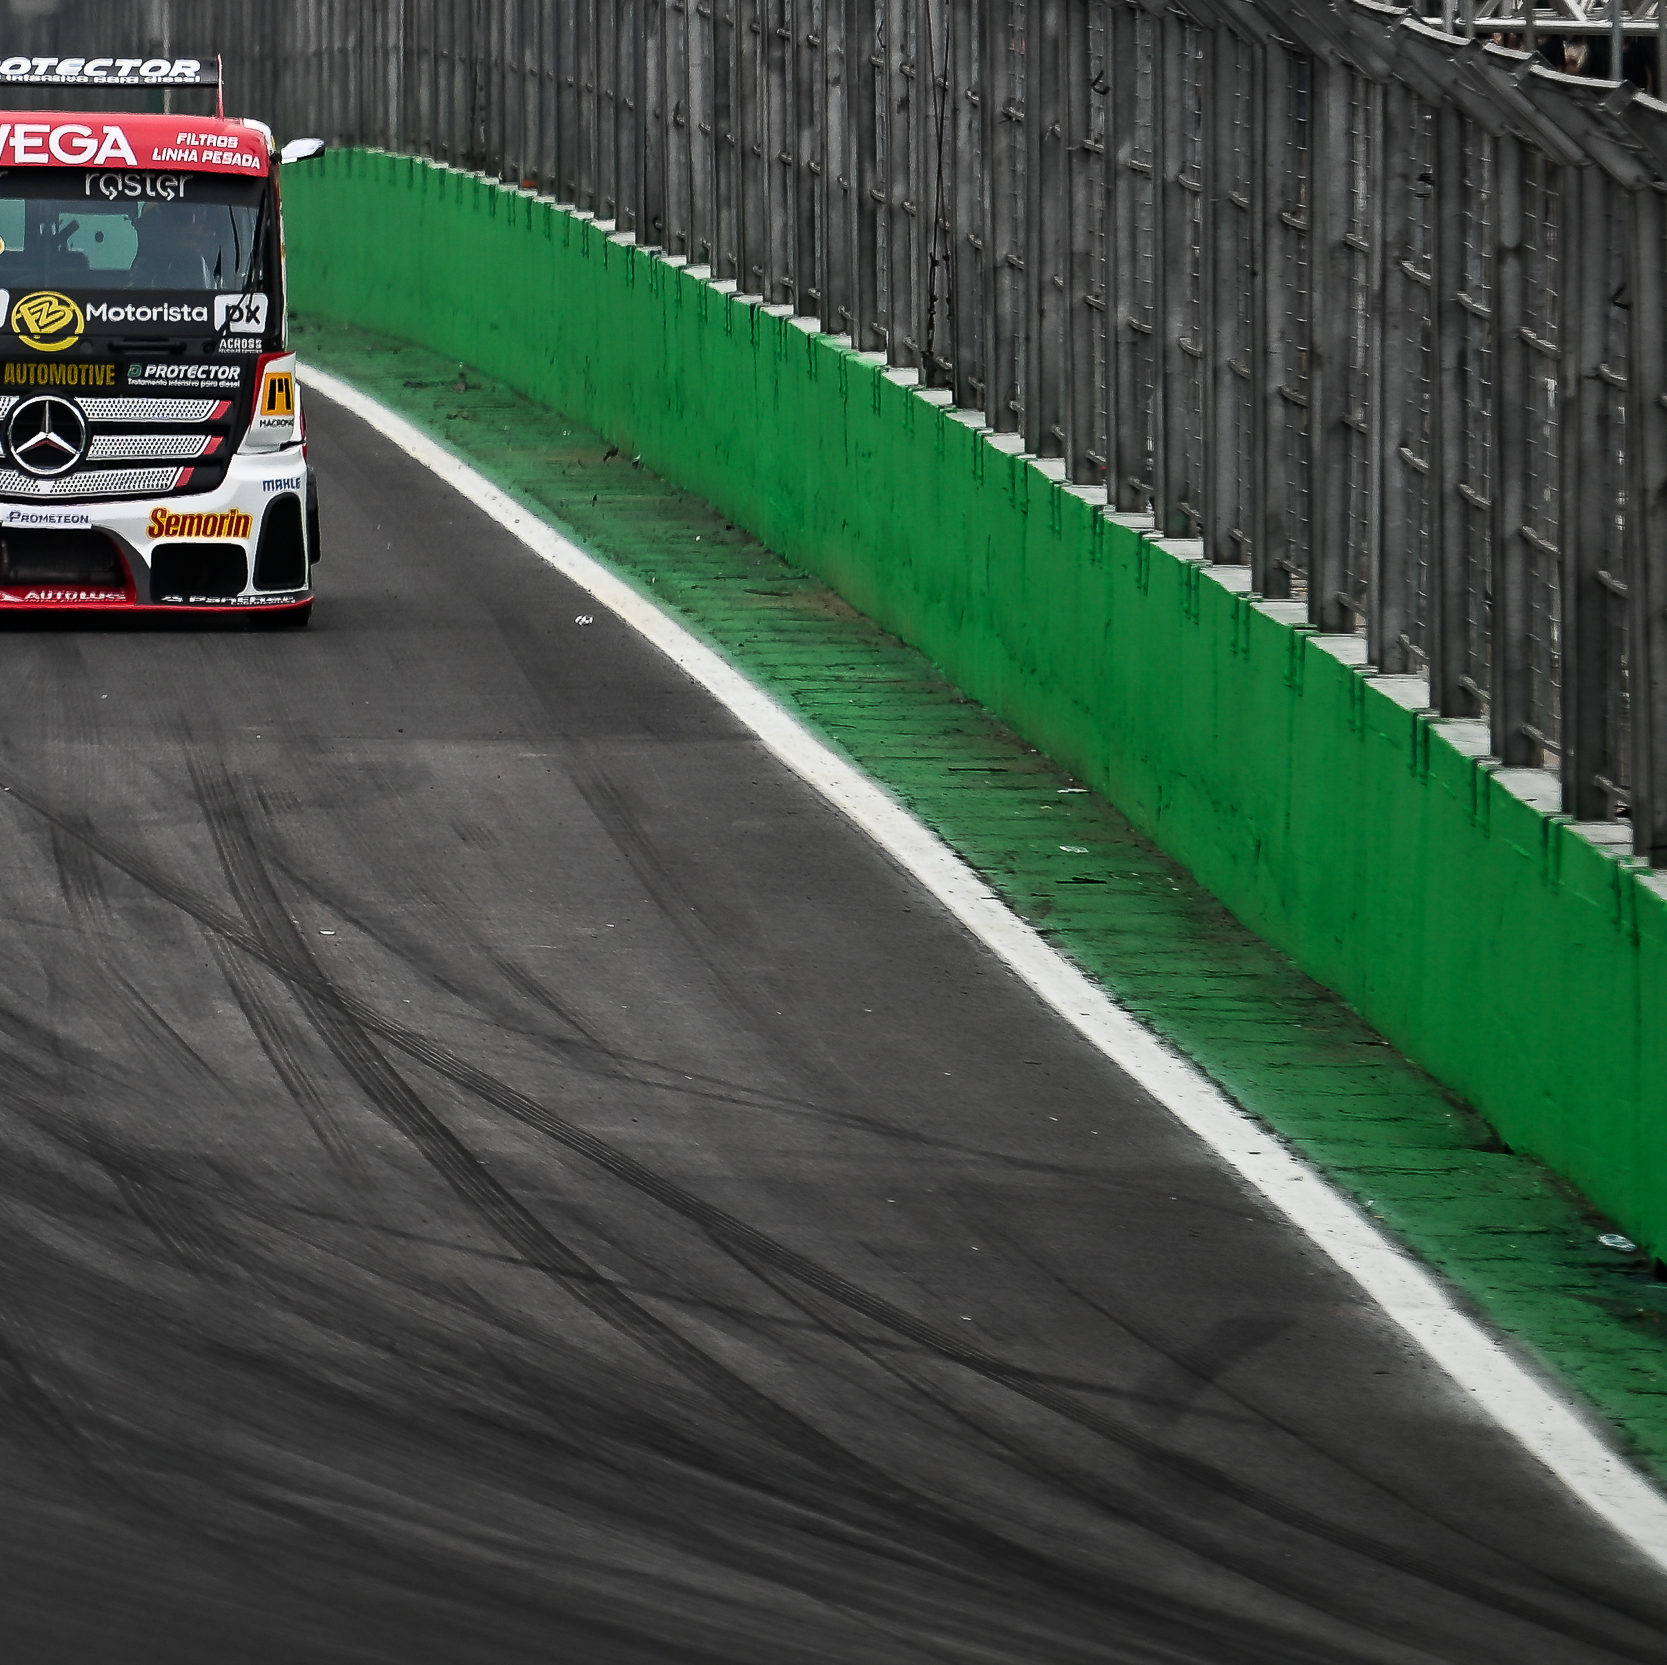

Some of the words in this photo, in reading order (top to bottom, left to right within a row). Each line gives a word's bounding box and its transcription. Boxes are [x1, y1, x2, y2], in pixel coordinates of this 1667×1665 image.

[176, 133, 239, 149] FILTROS
[151, 147, 198, 163] LINHA
[201, 149, 261, 170] PESADA
[85, 302, 208, 323] Motorista
[219, 338, 263, 349] ACROSS
[4, 363, 115, 385] AUTOMOTIVE
[144, 365, 241, 380] PROTECTOR
[262, 477, 301, 492] MAHLE
[5, 510, 89, 525] PROMETEON
[147, 507, 253, 539] Semorin
